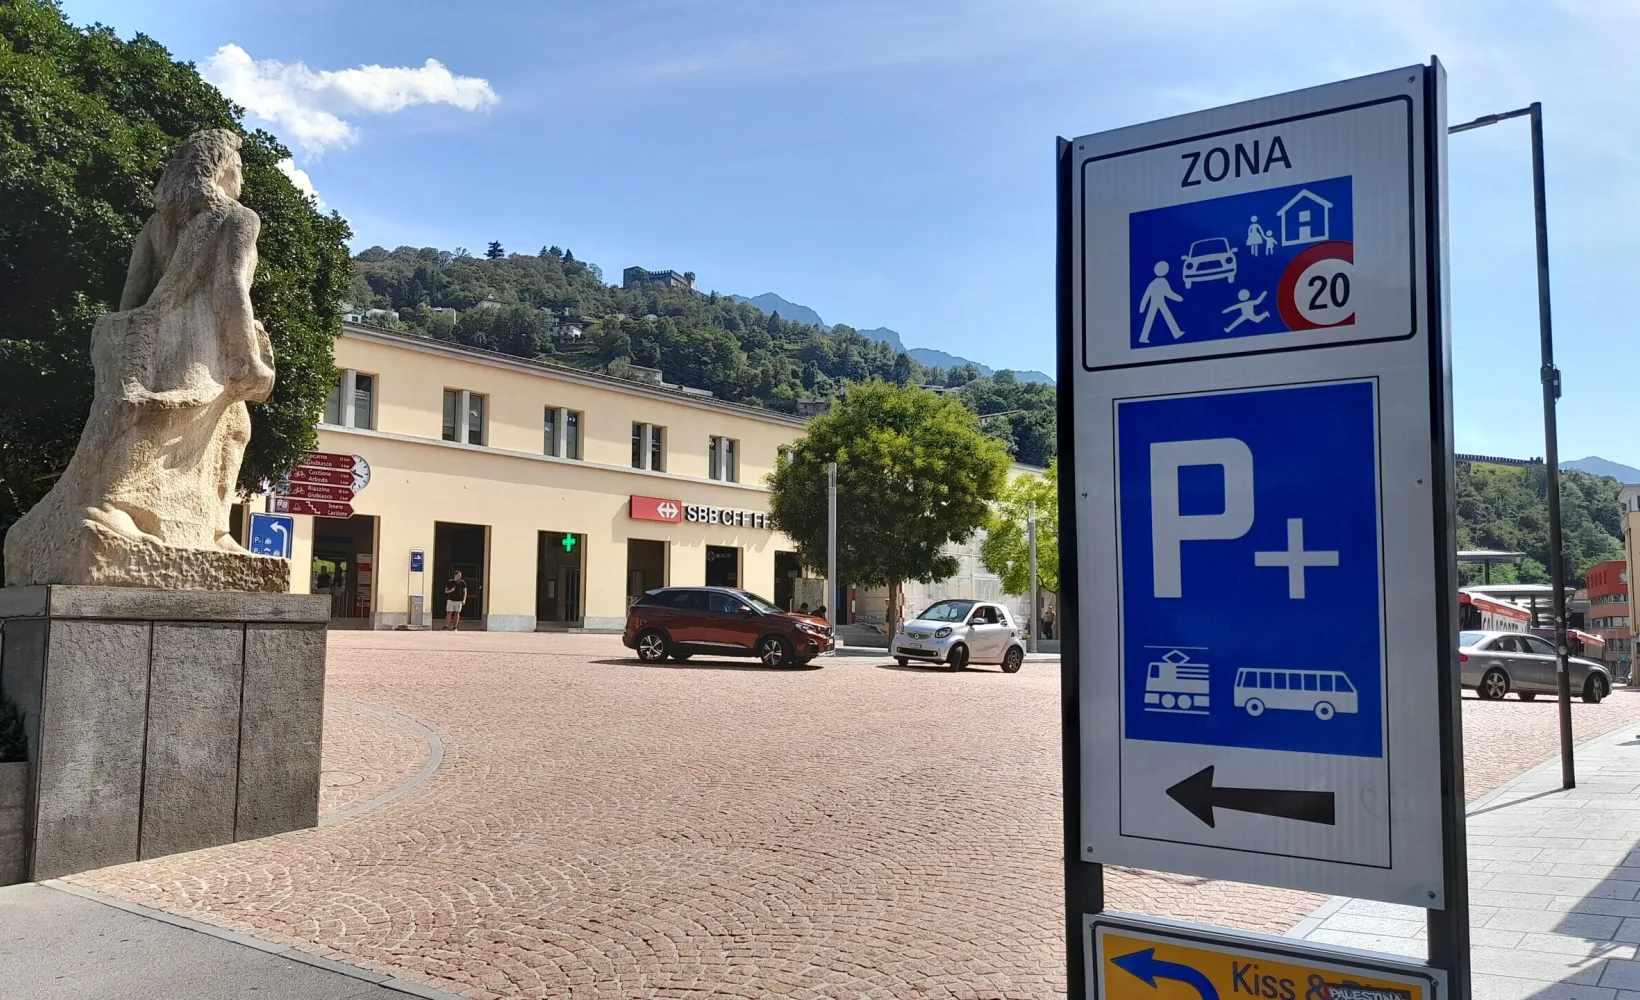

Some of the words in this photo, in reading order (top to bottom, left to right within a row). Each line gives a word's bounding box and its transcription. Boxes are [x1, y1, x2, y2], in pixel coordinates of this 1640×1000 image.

[1181, 136, 1292, 188] ZONA
[1308, 272, 1350, 311] 20
[687, 505, 719, 524] SBB
[722, 509, 752, 528] CFF
[1232, 961, 1296, 1000] Kiss
